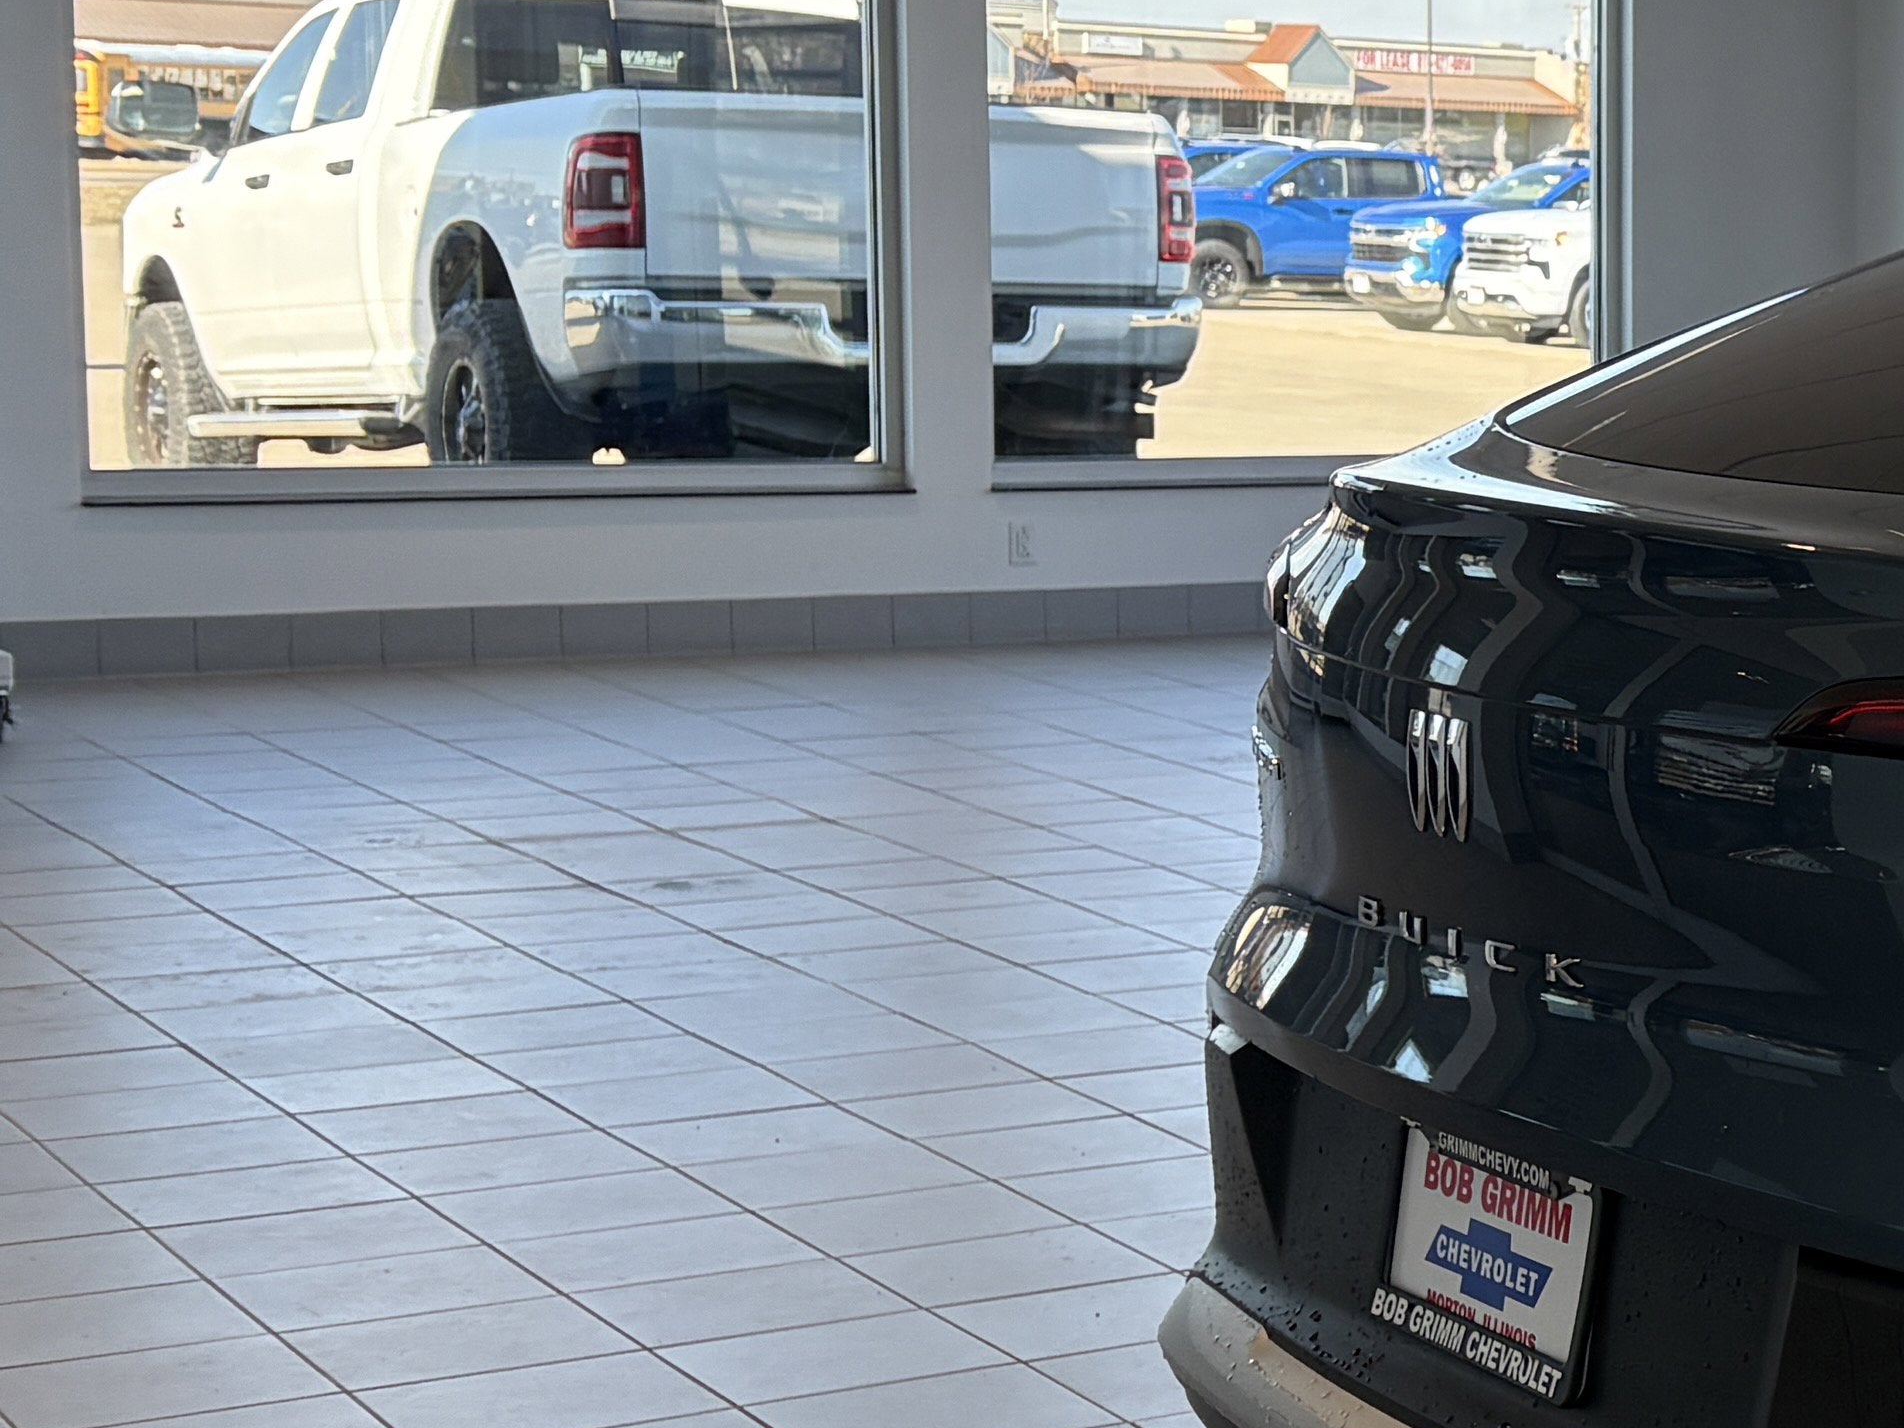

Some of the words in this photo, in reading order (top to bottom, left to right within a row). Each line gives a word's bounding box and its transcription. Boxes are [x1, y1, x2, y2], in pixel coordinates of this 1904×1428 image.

[1357, 894, 1585, 989] BUICK
[1424, 1150, 1475, 1204] BOB
[1481, 1173, 1573, 1244] GRIMM
[1438, 1131, 1550, 1191] GRIMMCHEVY.COM
[1436, 1233, 1539, 1297] CHEVROLET
[1371, 1287, 1408, 1325] BOB
[1408, 1300, 1467, 1354] GRIMM
[1465, 1331, 1563, 1399] CHEVROLET
